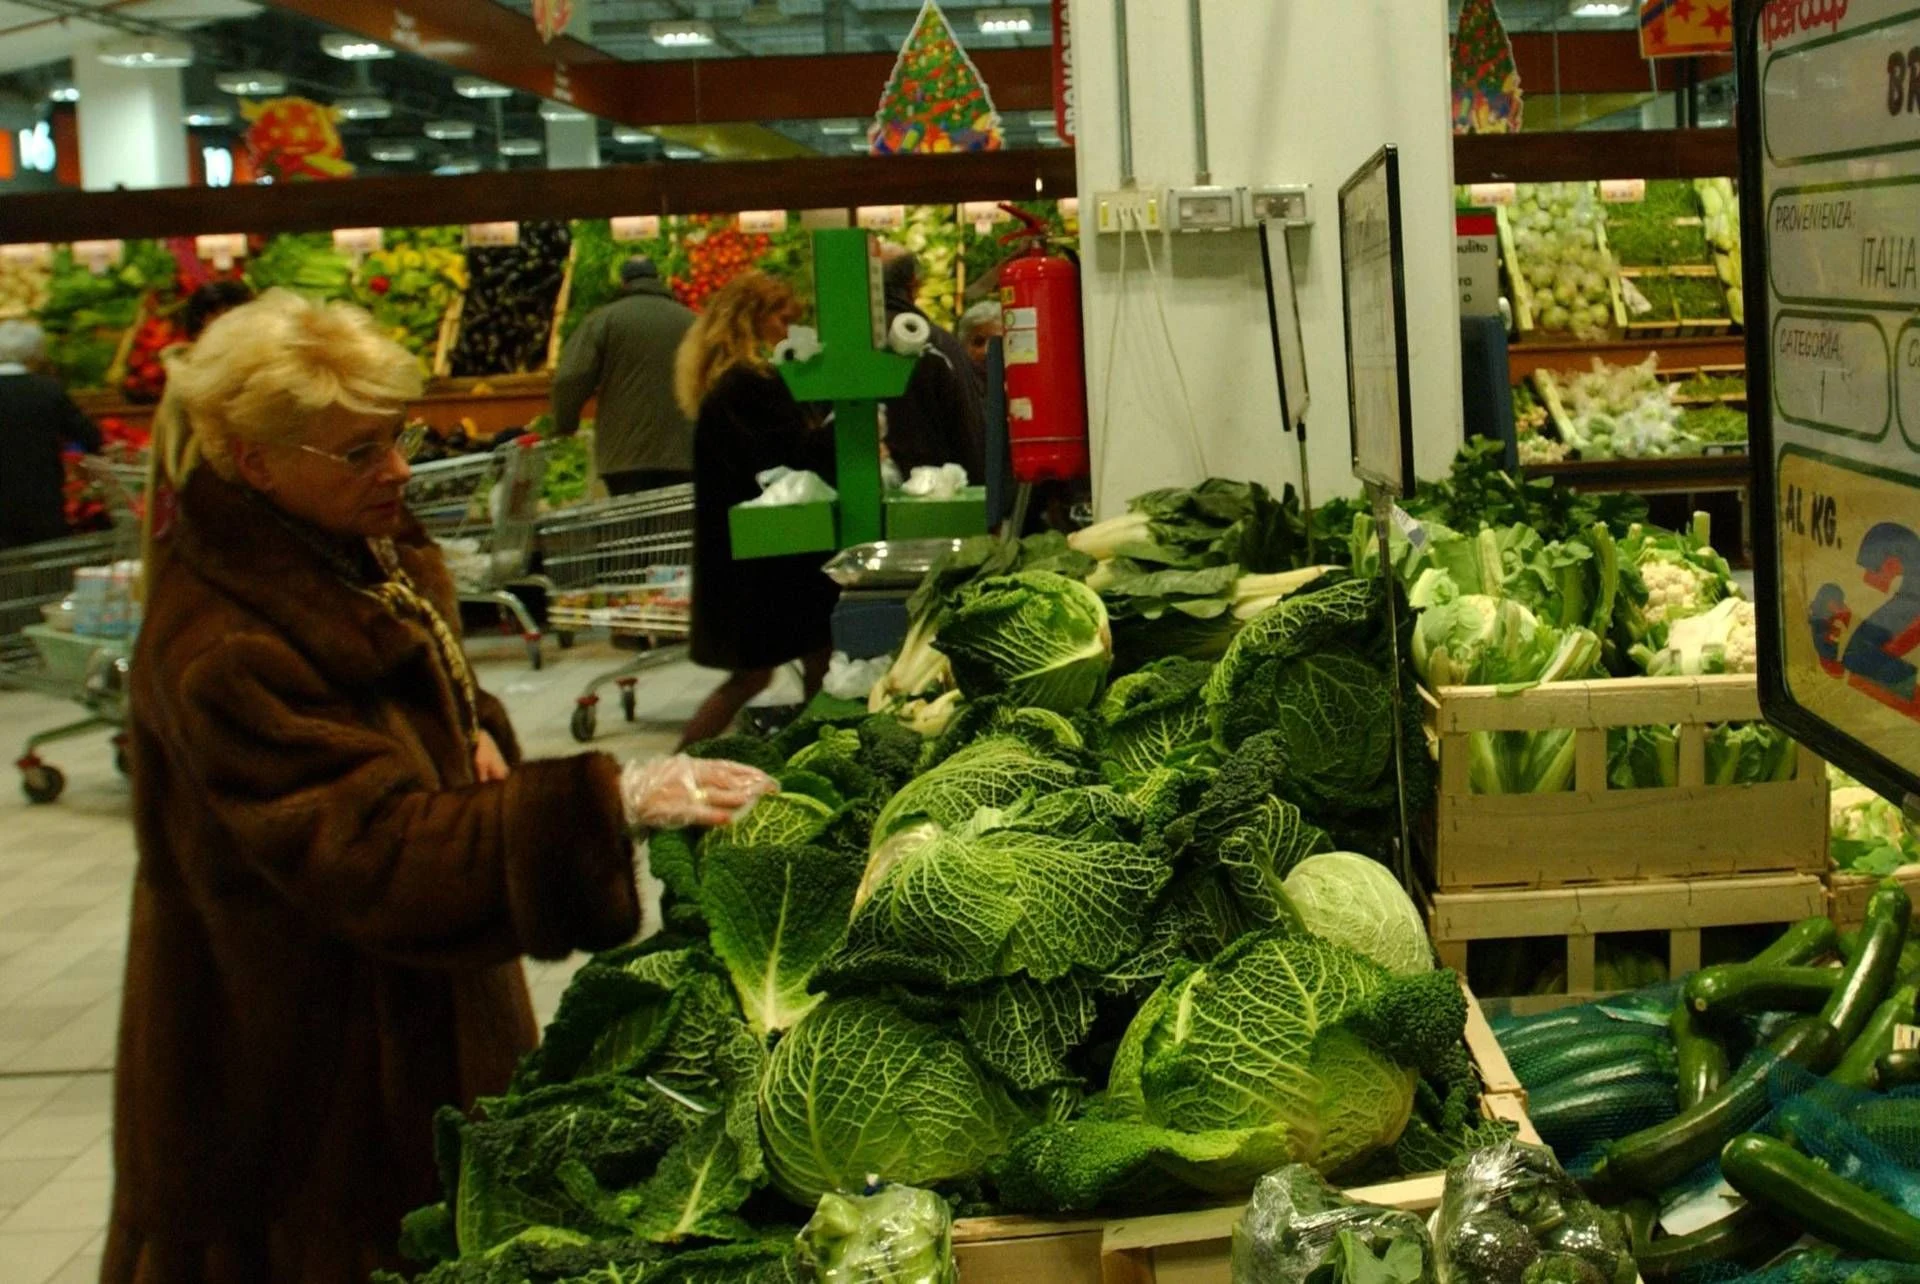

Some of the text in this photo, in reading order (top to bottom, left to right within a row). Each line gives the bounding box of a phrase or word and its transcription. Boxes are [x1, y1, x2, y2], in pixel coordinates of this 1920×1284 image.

[1860, 236, 1917, 288] ITALIA
[1786, 484, 1842, 549] AL KG.
